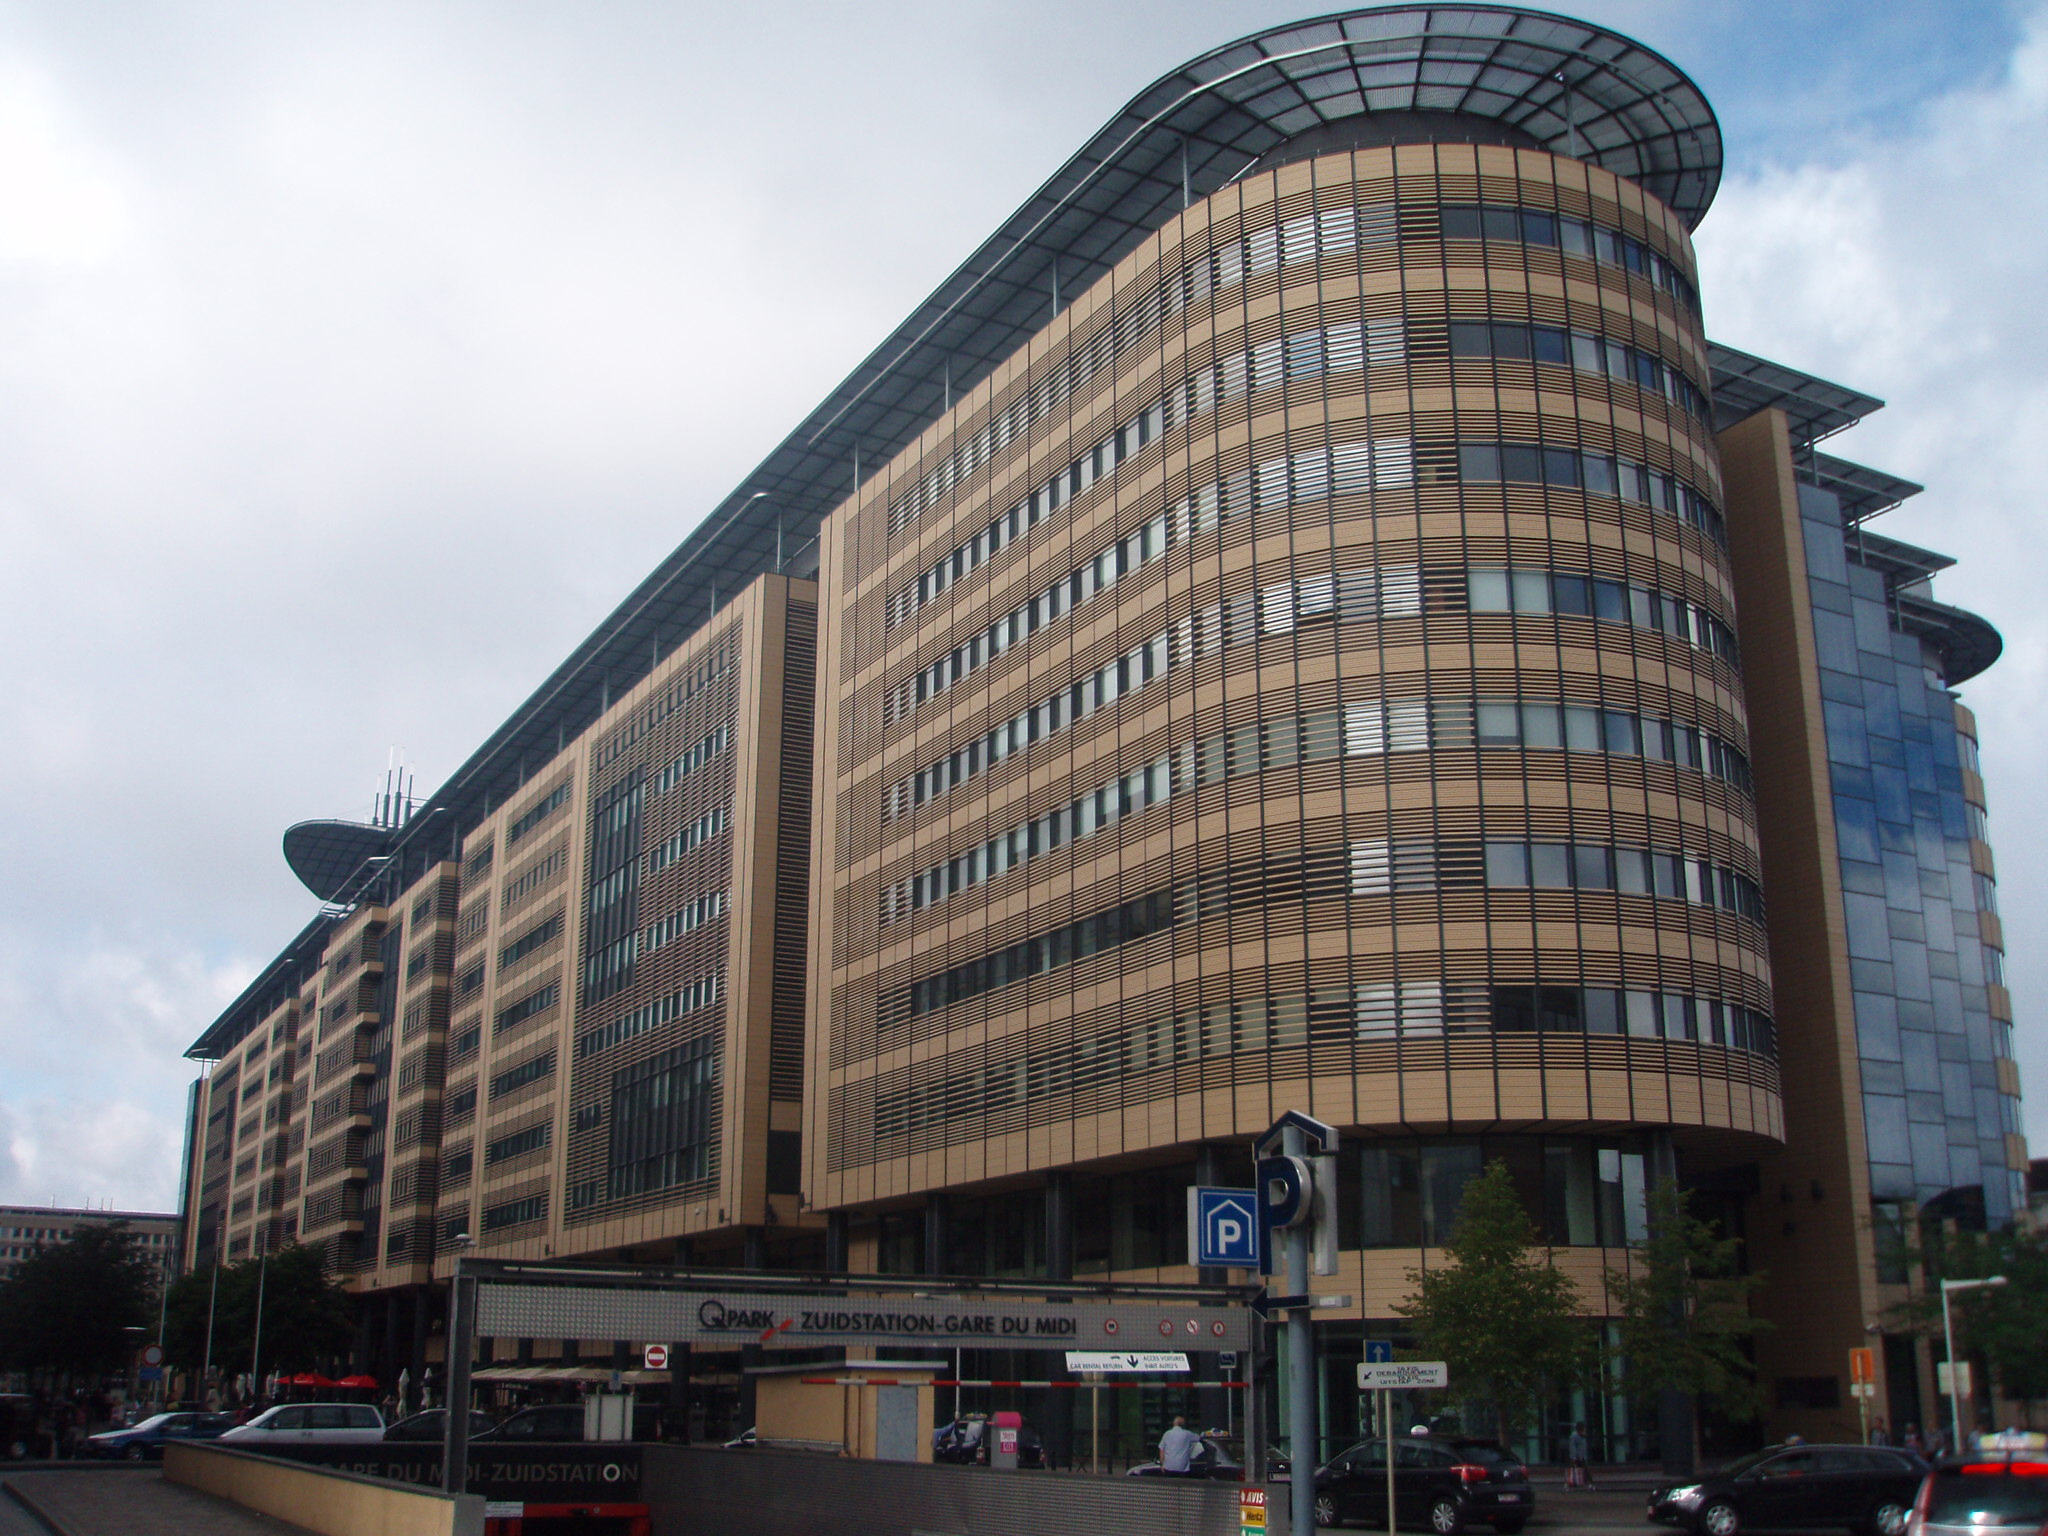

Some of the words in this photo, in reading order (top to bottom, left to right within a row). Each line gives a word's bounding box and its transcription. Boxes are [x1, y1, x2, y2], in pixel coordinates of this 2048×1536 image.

[1218, 1218, 1242, 1255] P
[1002, 1316, 1029, 1334] DU
[1035, 1317, 1077, 1334] MIDI
[387, 1463, 421, 1482] DU
[1246, 1491, 1264, 1504] AVIS
